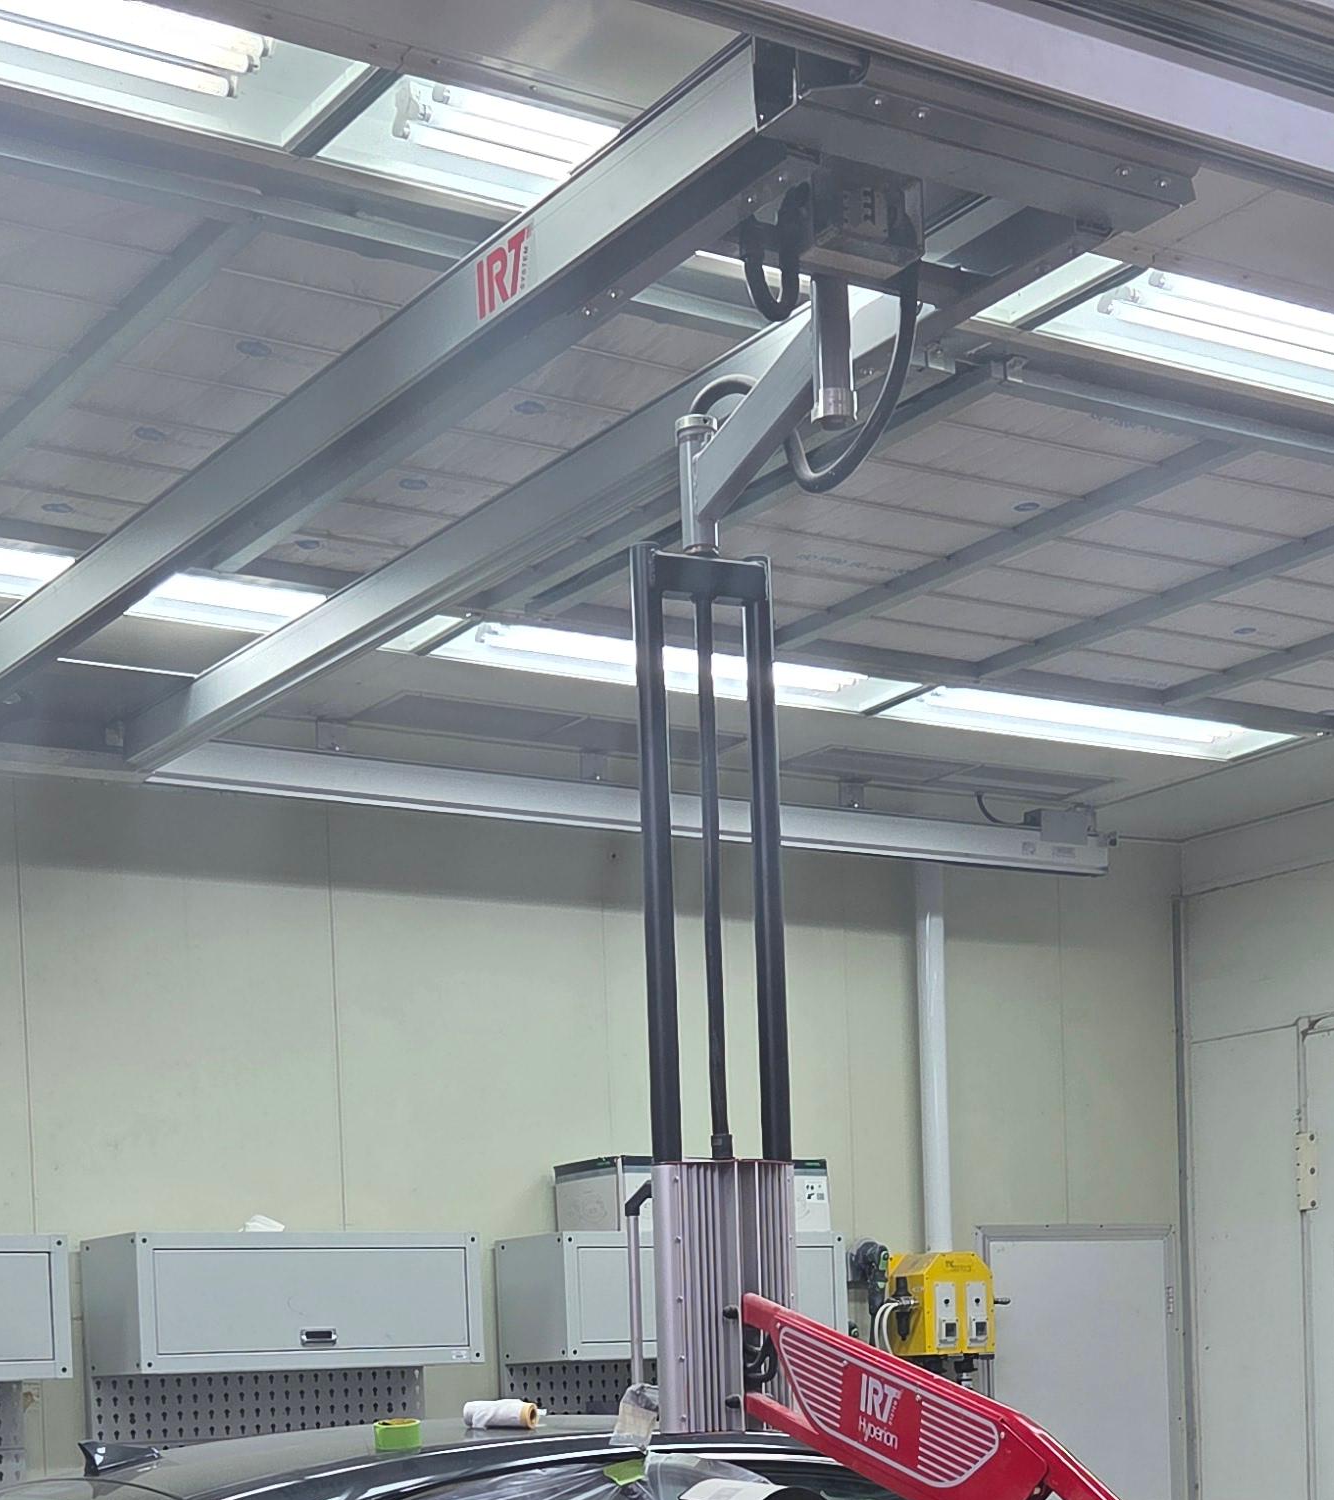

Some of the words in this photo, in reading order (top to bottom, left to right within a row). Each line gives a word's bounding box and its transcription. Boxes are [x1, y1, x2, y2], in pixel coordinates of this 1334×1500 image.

[476, 227, 526, 320] IRT
[859, 1372, 901, 1424] IRT
[858, 1415, 899, 1451] Hyperion
